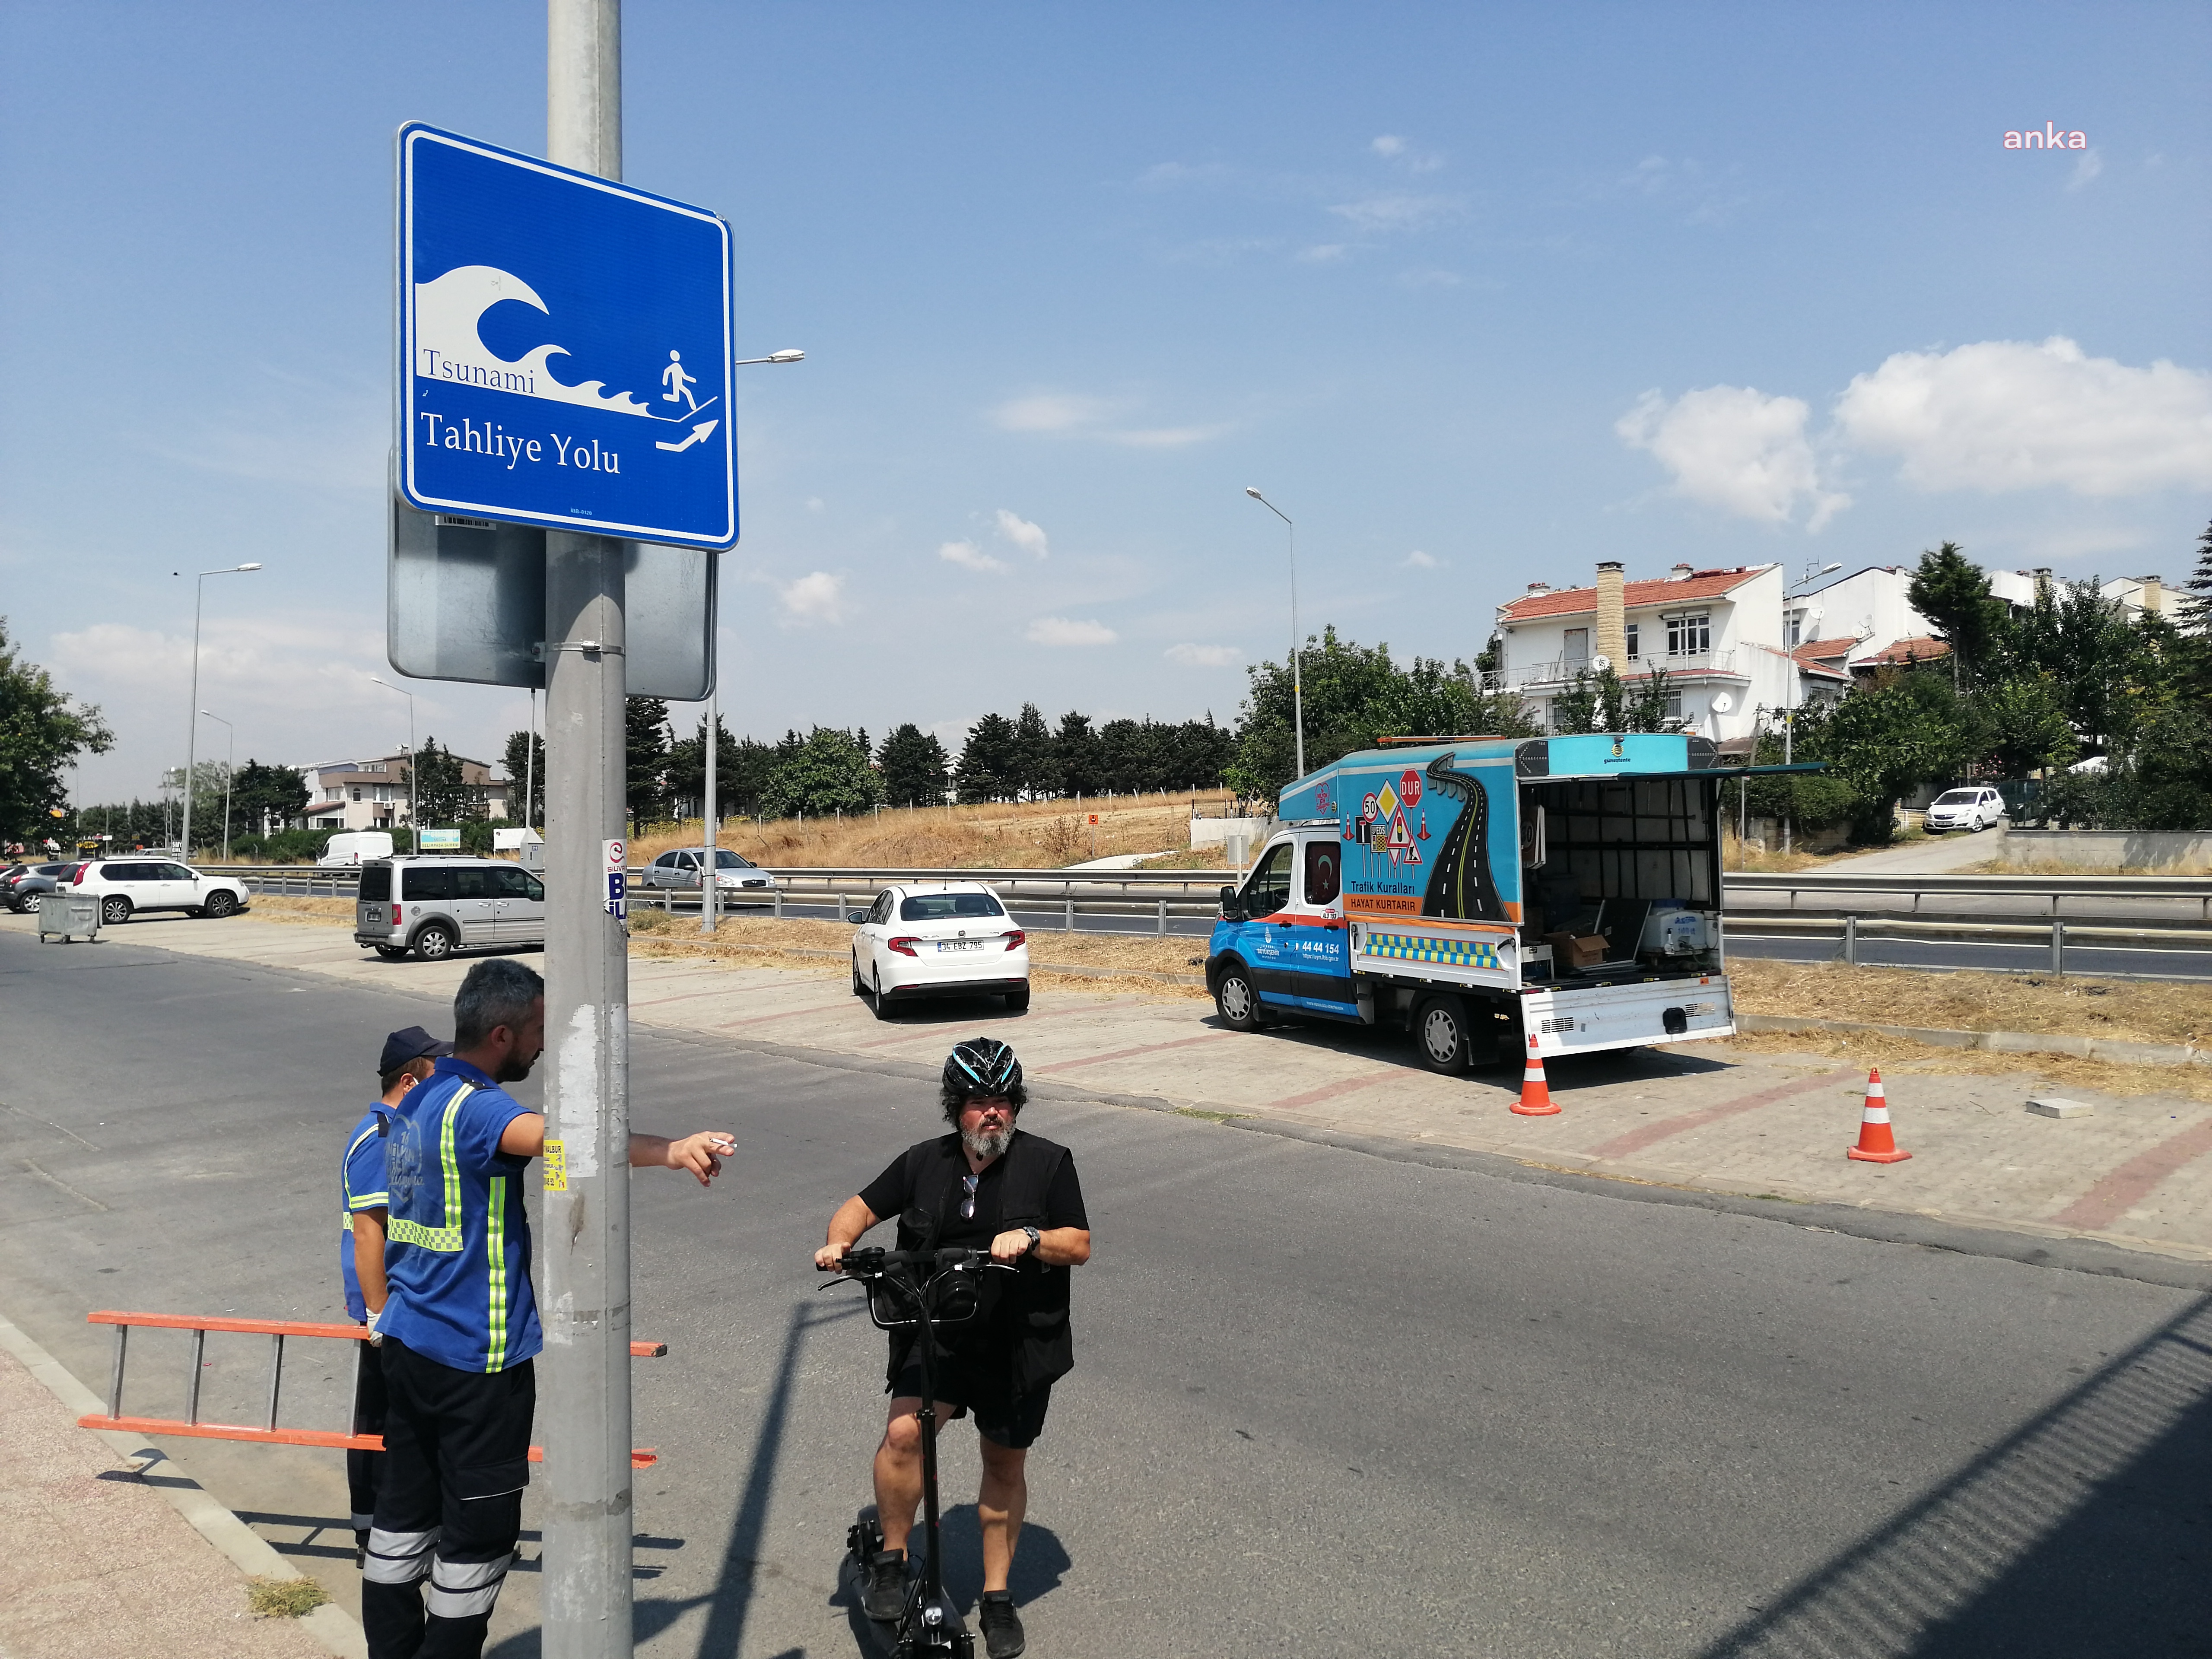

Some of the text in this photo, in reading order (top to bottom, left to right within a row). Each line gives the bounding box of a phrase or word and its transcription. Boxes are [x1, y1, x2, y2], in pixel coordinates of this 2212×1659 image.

[423, 349, 535, 394] Tsunami
[420, 412, 620, 474] Tahliye Yolu
[1402, 781, 1420, 795] DUR
[1365, 801, 1375, 814] 50
[1376, 826, 1385, 835] EDS
[608, 873, 627, 900] B
[1351, 881, 1414, 894] Trafik Kuralları
[1351, 899, 1415, 911] HAYAT KURTARIR
[953, 942, 966, 950] EBZ
[969, 941, 982, 949] 795
[1302, 941, 1339, 954] 44 44 154
